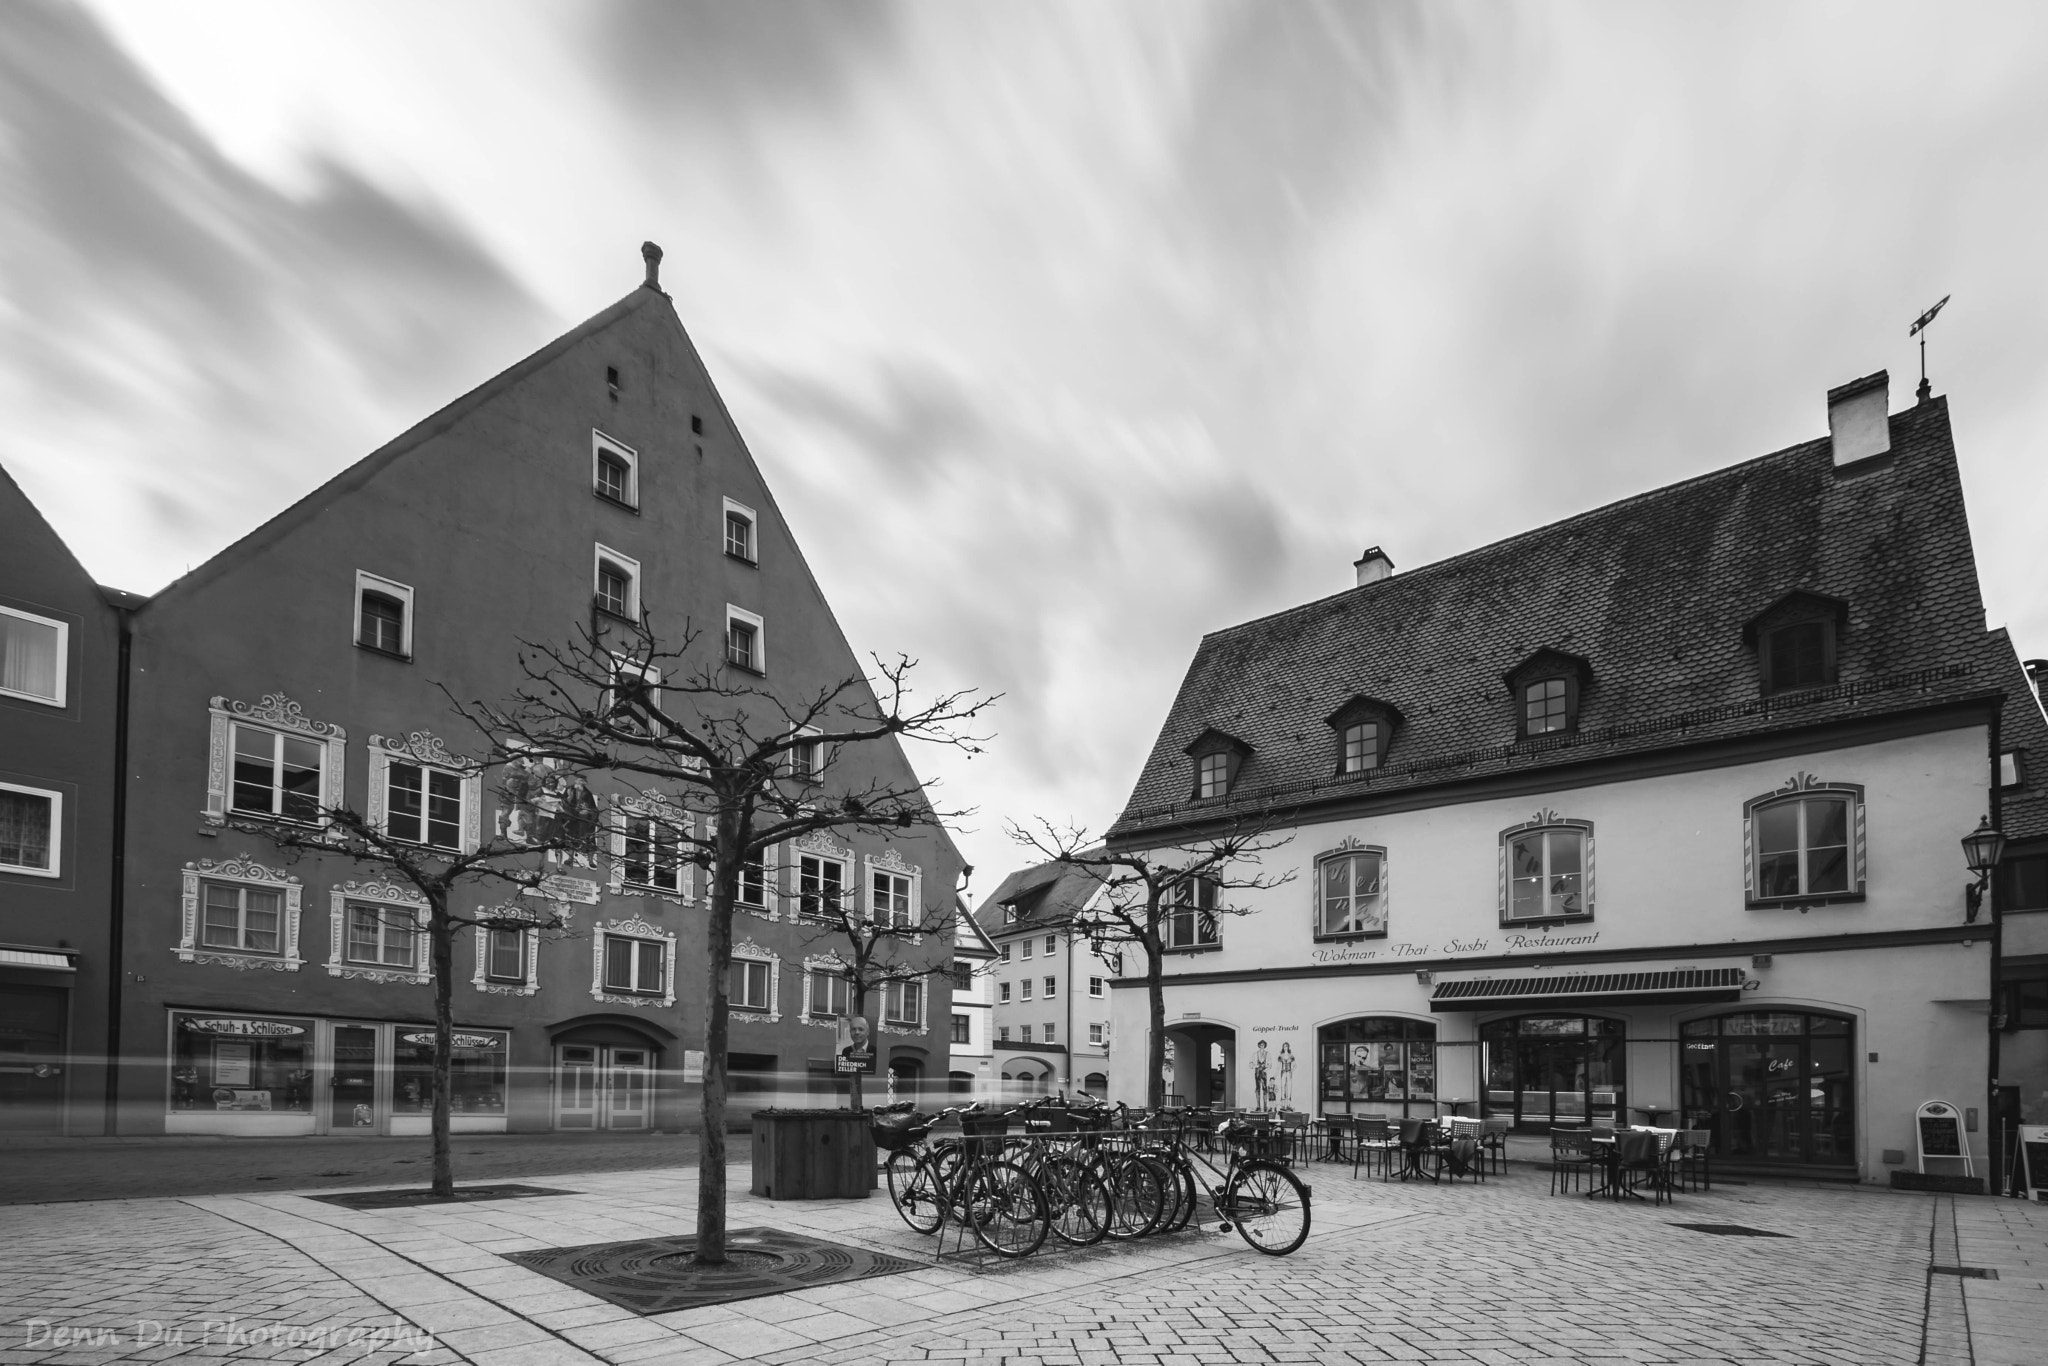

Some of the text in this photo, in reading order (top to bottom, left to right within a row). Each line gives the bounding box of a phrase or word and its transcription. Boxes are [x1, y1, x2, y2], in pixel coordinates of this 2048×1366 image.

[1312, 949, 1375, 962] Wokman
[1391, 943, 1429, 957] Thai
[1443, 938, 1488, 954] Sushi
[1505, 931, 1600, 949] Restaurant
[242, 1023, 248, 1034] &
[415, 1034, 436, 1045] Schu
